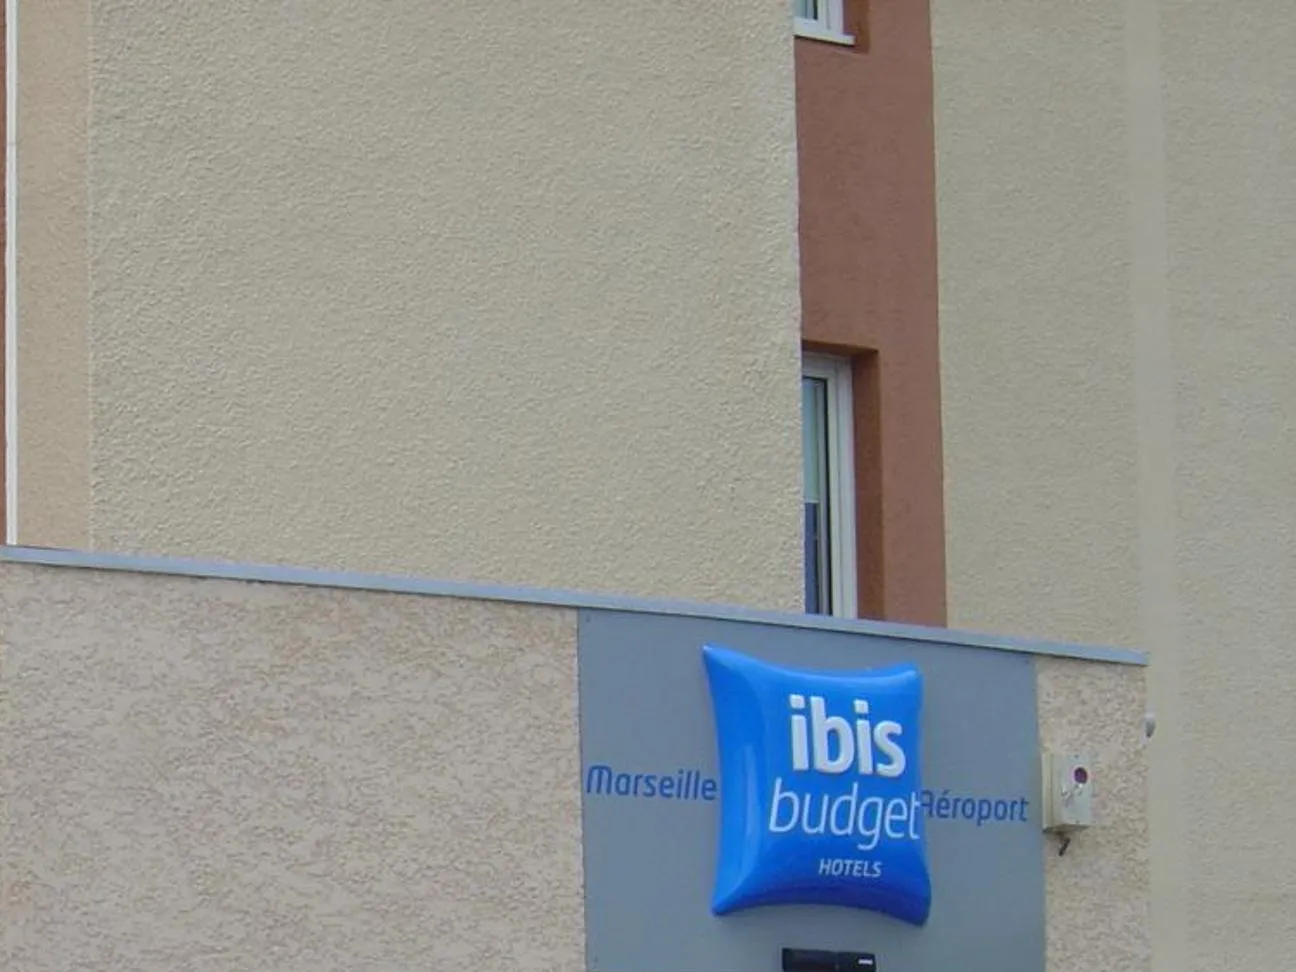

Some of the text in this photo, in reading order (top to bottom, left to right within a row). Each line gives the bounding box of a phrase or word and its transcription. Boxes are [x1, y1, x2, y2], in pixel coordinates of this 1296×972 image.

[789, 693, 906, 778] ibis
[586, 764, 718, 801] Marseille
[768, 776, 921, 851] budget
[818, 857, 882, 878] HOTELS
